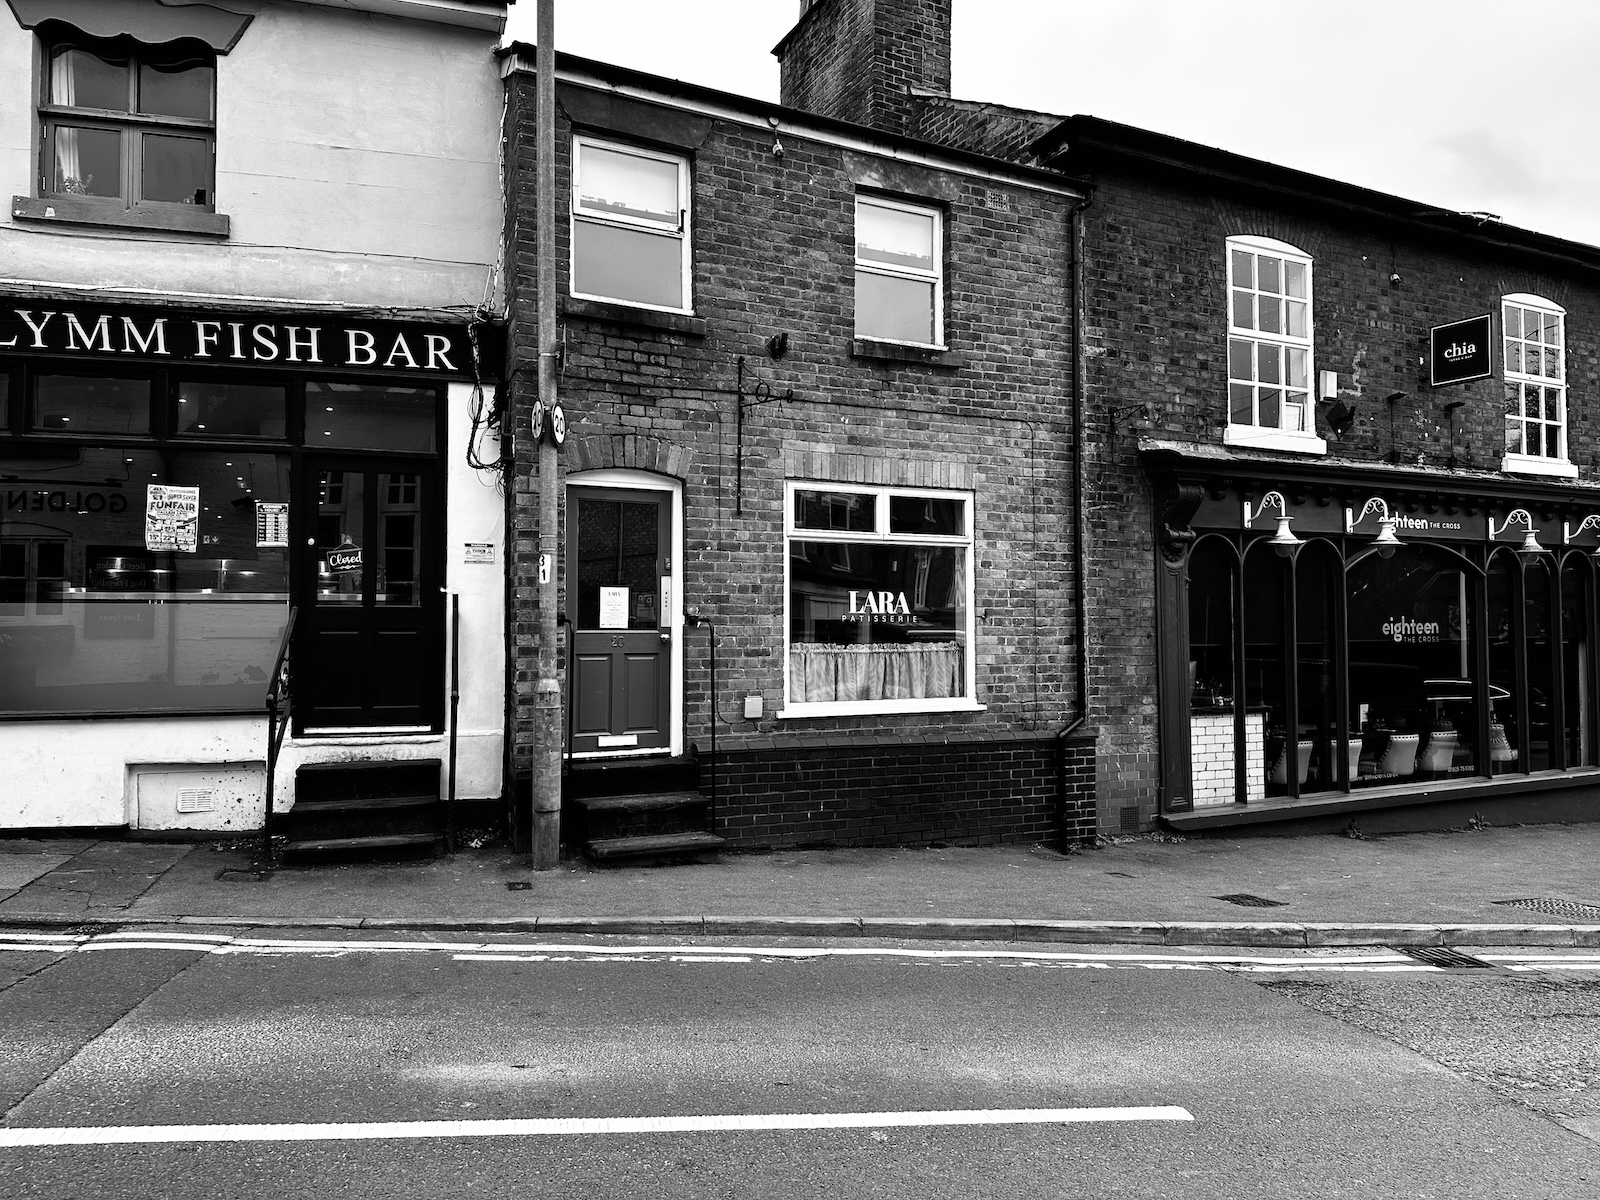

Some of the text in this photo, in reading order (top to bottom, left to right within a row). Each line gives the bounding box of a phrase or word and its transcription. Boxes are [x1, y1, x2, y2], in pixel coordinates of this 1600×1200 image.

[192, 320, 323, 363] FISH
[344, 329, 458, 370] BAR
[1443, 341, 1476, 358] chia
[554, 414, 565, 435] 20
[149, 500, 196, 512] FUNFAIR
[1378, 511, 1428, 534] eghteen
[1442, 522, 1461, 530] CROSS
[330, 550, 363, 567] Closed
[848, 590, 911, 615] LARA
[841, 615, 917, 623] PATISSERIE
[1382, 615, 1440, 643] eighteen
[611, 634, 625, 648] 20
[1418, 635, 1440, 643] CROSS
